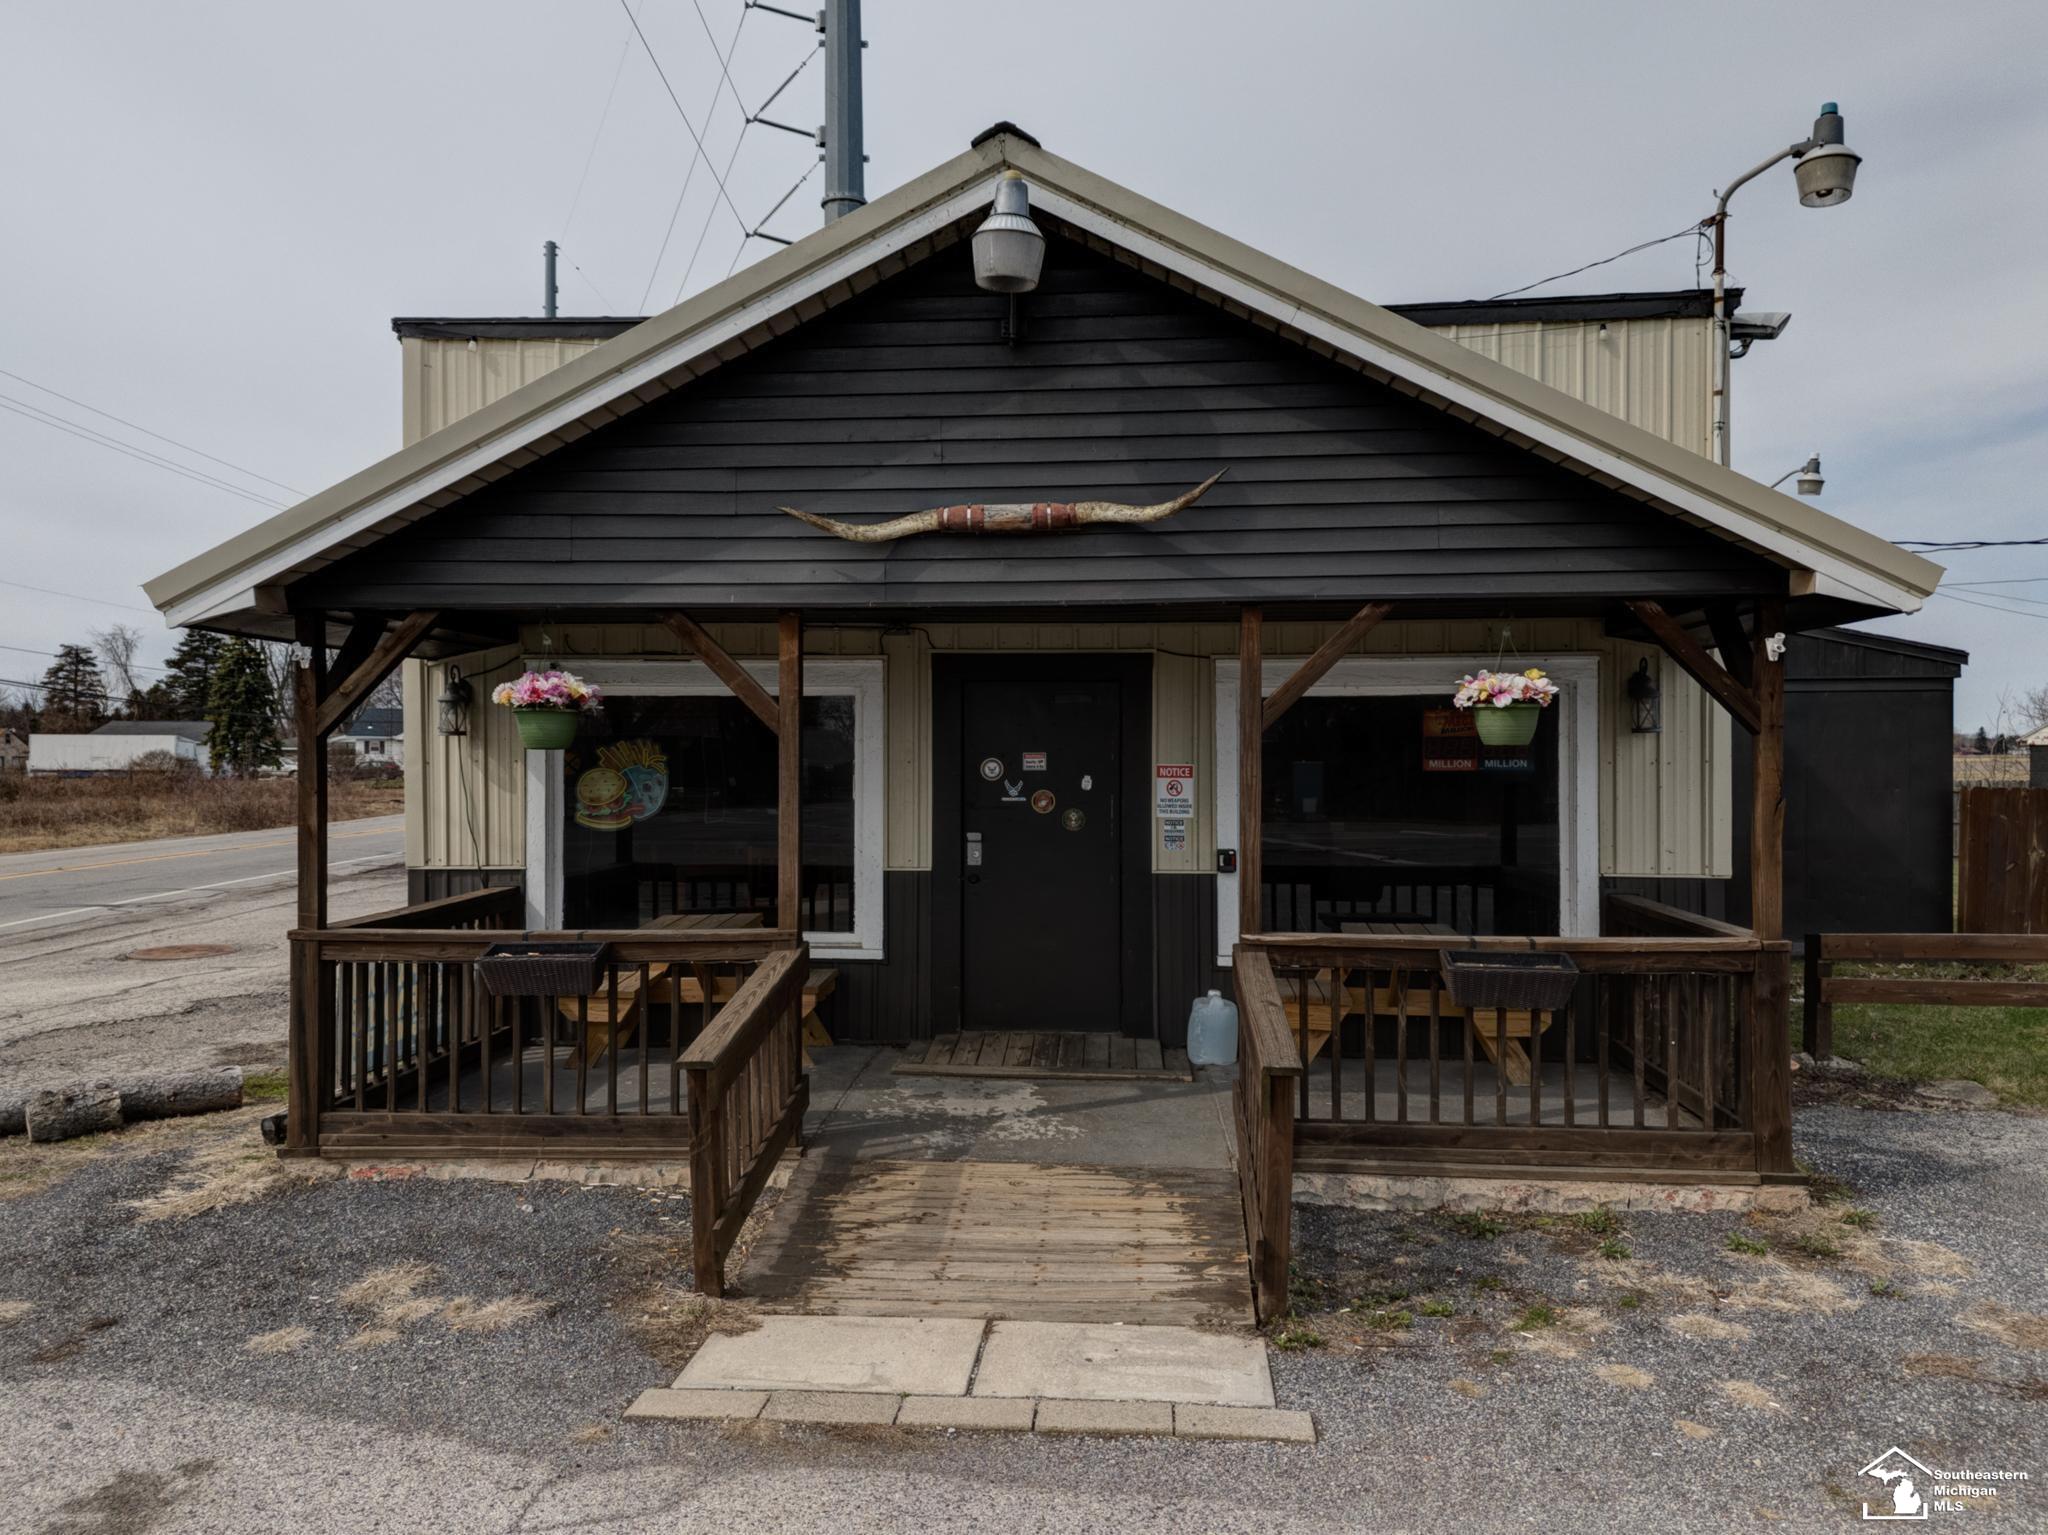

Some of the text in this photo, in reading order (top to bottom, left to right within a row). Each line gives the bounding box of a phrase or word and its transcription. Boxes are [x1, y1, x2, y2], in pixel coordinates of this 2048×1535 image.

[1429, 759, 1472, 768] MILLION
[1484, 759, 1528, 768] MILLION
[1159, 767, 1191, 777] NOTICE
